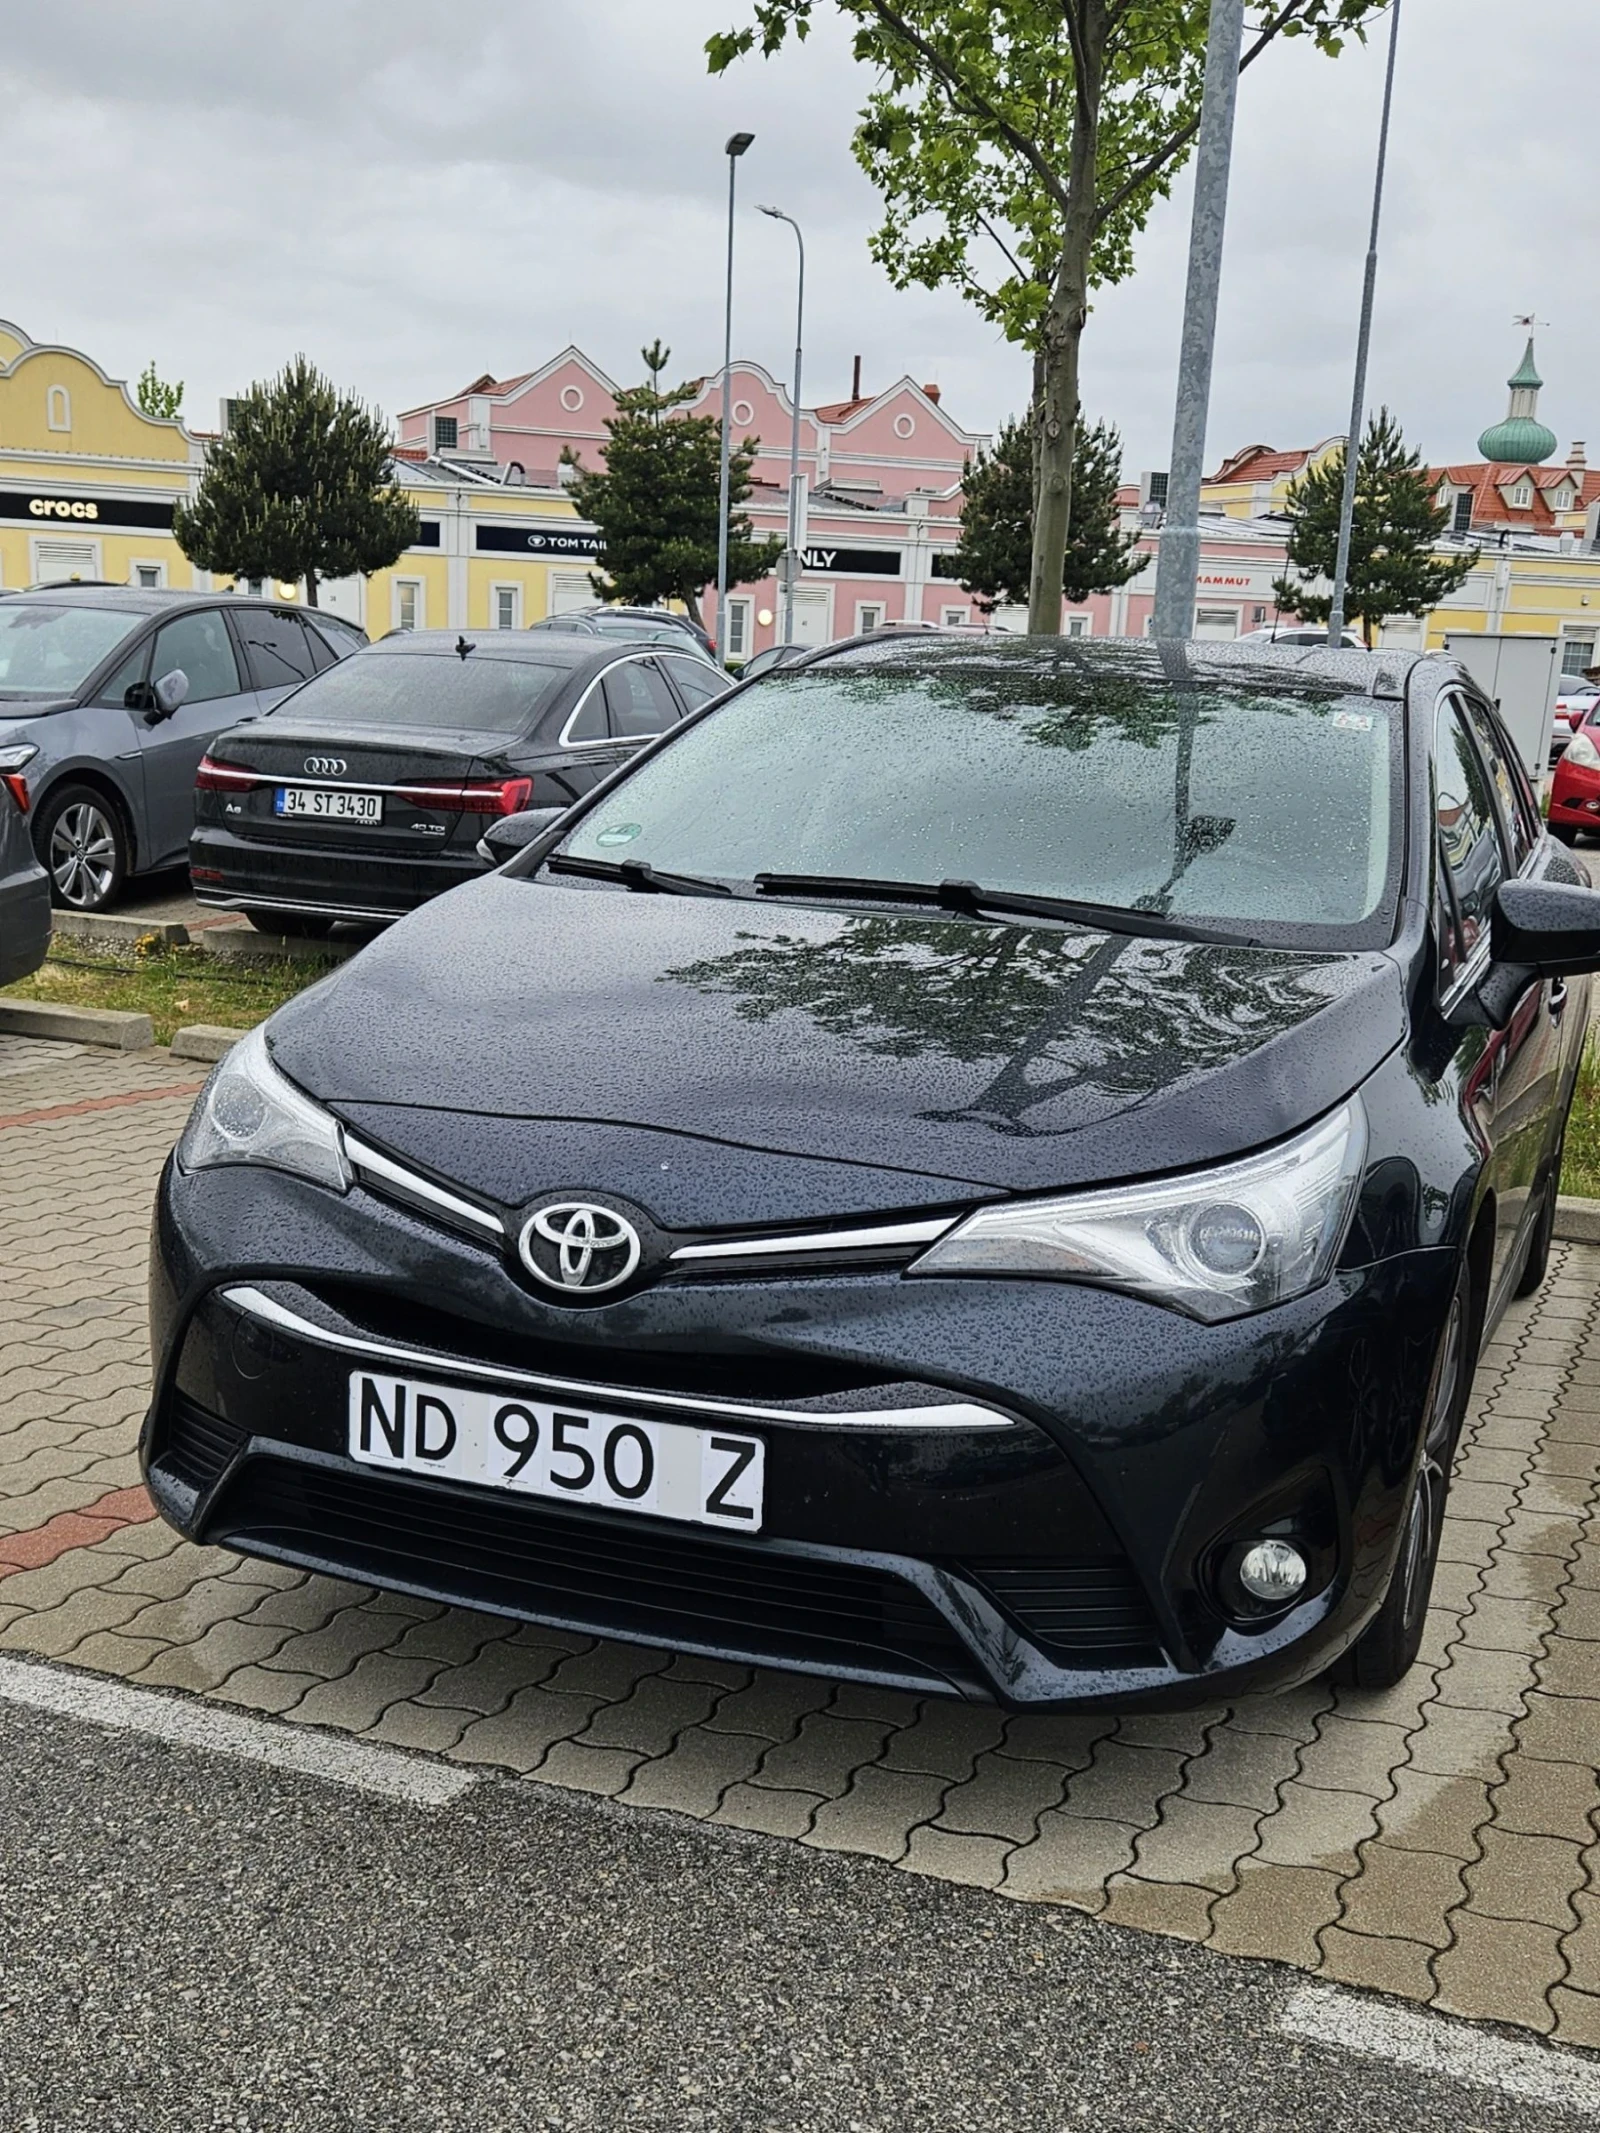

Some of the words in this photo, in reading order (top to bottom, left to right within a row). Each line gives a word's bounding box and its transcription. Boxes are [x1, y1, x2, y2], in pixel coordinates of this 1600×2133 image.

[29, 499, 98, 519] crocs
[547, 537, 578, 549] TOM
[287, 791, 306, 811] 34
[313, 793, 333, 814] ST
[336, 795, 376, 817] 3430
[359, 1377, 457, 1461] ND
[493, 1403, 654, 1500] 950
[705, 1436, 757, 1520] Z
